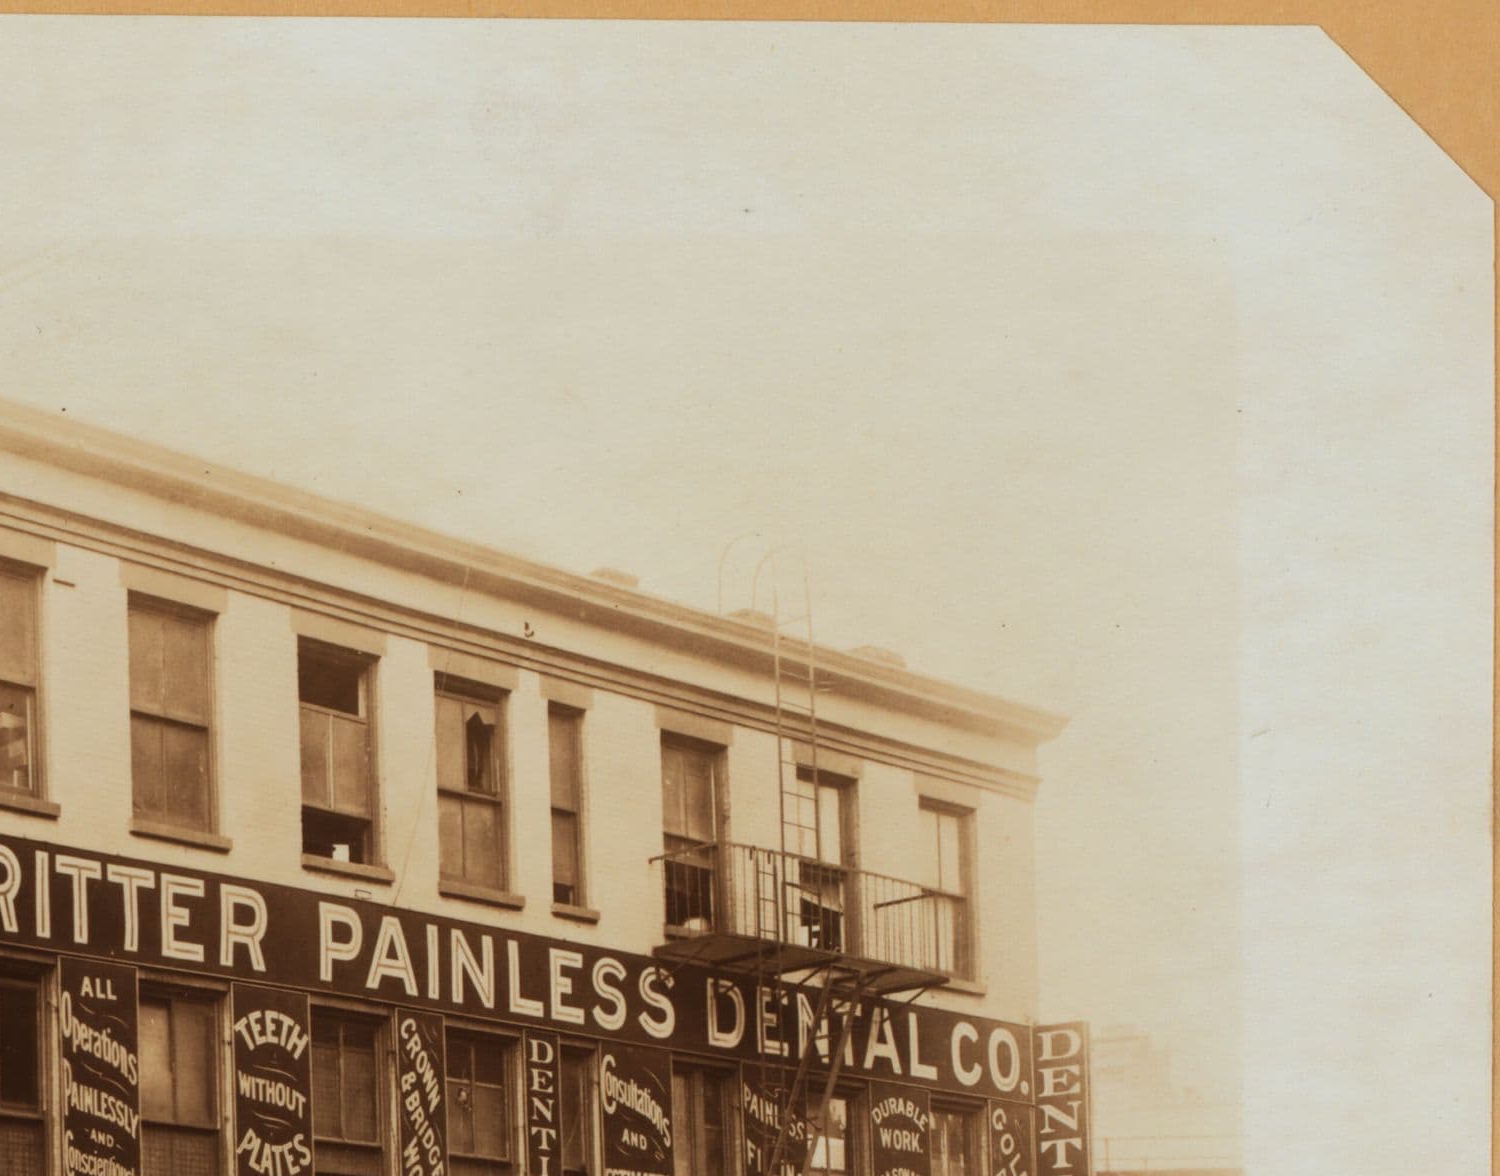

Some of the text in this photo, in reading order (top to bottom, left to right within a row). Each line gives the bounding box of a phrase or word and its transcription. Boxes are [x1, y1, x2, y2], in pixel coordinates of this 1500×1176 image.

[80, 975, 117, 1001] ALL
[318, 901, 677, 1039] PAINLESS
[706, 977, 938, 1081] DENTAL
[951, 1021, 1030, 1095] CO.
[61, 990, 138, 1087] Operations
[233, 1010, 309, 1060] TEETH
[400, 1017, 441, 1113] CROWN
[401, 1070, 417, 1092] &
[236, 1069, 307, 1119] WITHOUT
[601, 1053, 672, 1148] Consultations
[743, 1082, 805, 1141] PAINLS
[871, 1098, 930, 1132] DURABLE
[90, 1127, 115, 1148] AND
[621, 1127, 648, 1150] AND
[879, 1127, 924, 1154] WORK.
